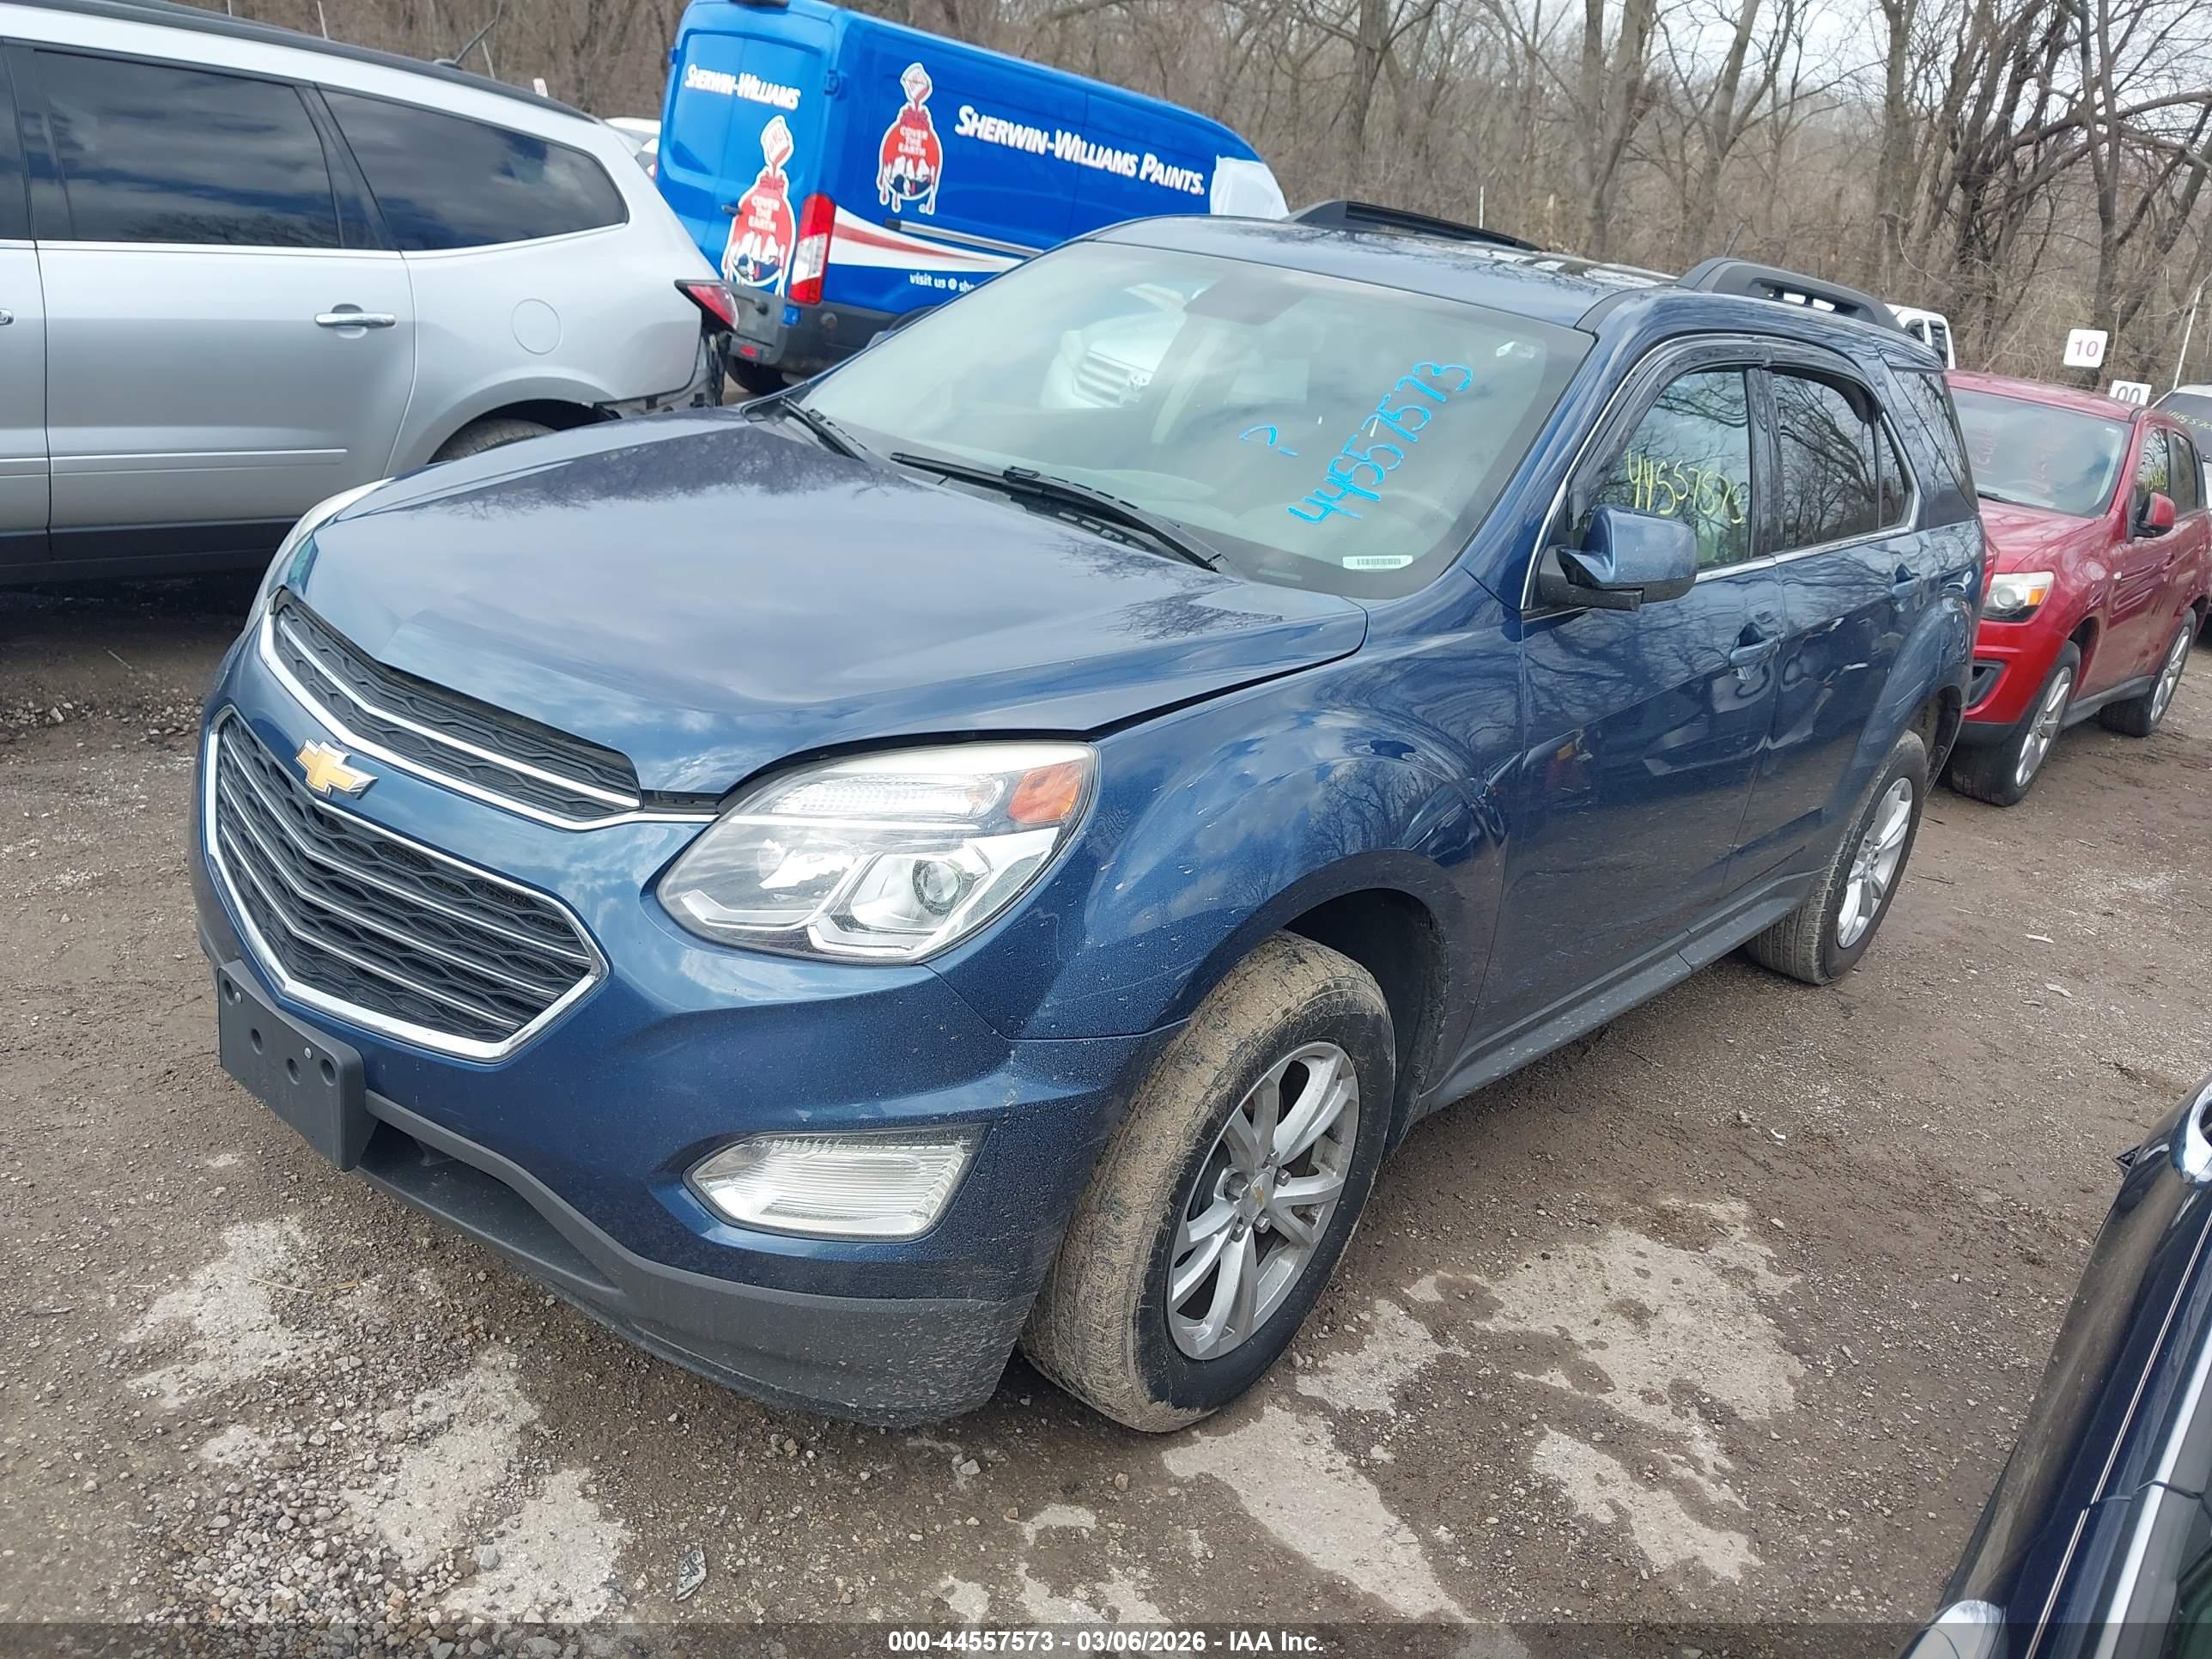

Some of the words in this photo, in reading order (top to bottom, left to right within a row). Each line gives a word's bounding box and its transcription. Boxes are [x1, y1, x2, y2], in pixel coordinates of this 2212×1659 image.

[684, 64, 802, 111] SHERWIN-WILLIAMS
[955, 105, 1139, 178] SHERWIN-WILLIAMS
[909, 272, 933, 287] visit
[933, 277, 945, 289] us
[947, 277, 957, 290] @
[2075, 339, 2099, 357] 10
[1286, 362, 1473, 525] 44557573
